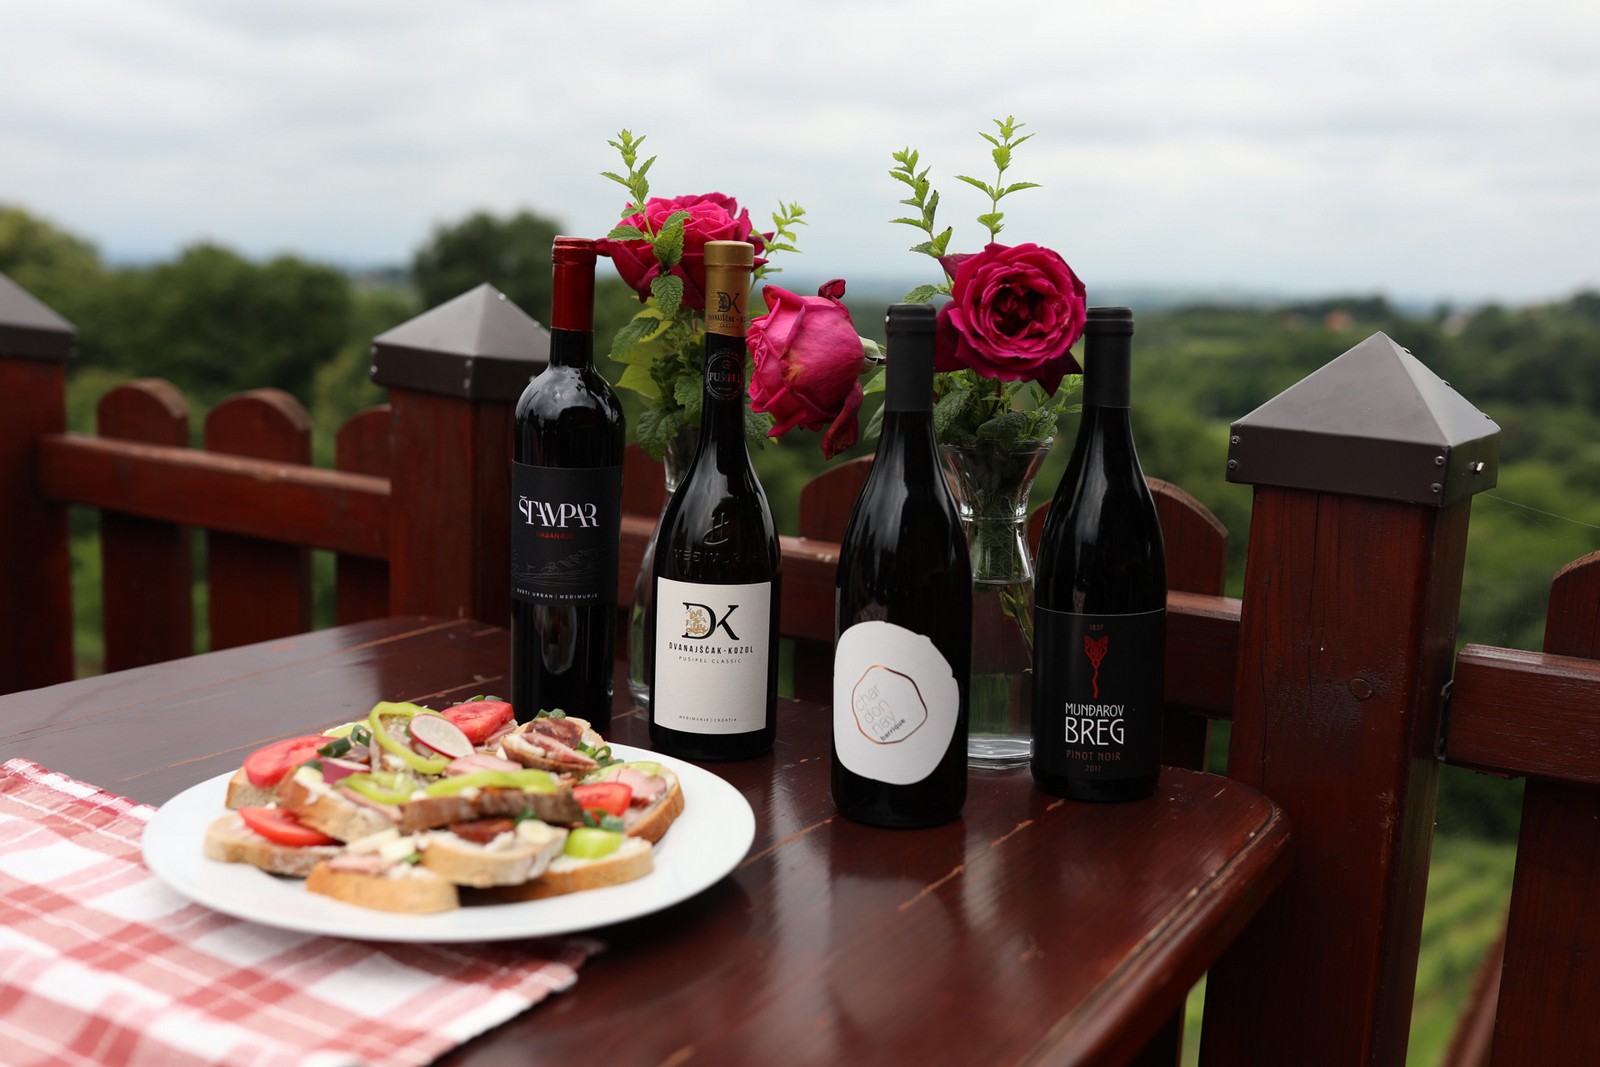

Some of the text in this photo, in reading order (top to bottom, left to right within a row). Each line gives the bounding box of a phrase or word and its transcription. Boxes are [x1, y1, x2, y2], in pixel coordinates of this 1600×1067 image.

[518, 495, 600, 528] ŠTAMPAR
[681, 602, 740, 641] DK
[678, 655, 707, 664] PUŠIPEL
[864, 699, 890, 724] don
[880, 718, 906, 741] barrique
[1065, 716, 1125, 746] BREG
[1066, 749, 1121, 761] PINOT NOIR
[1085, 764, 1102, 772] 2017
